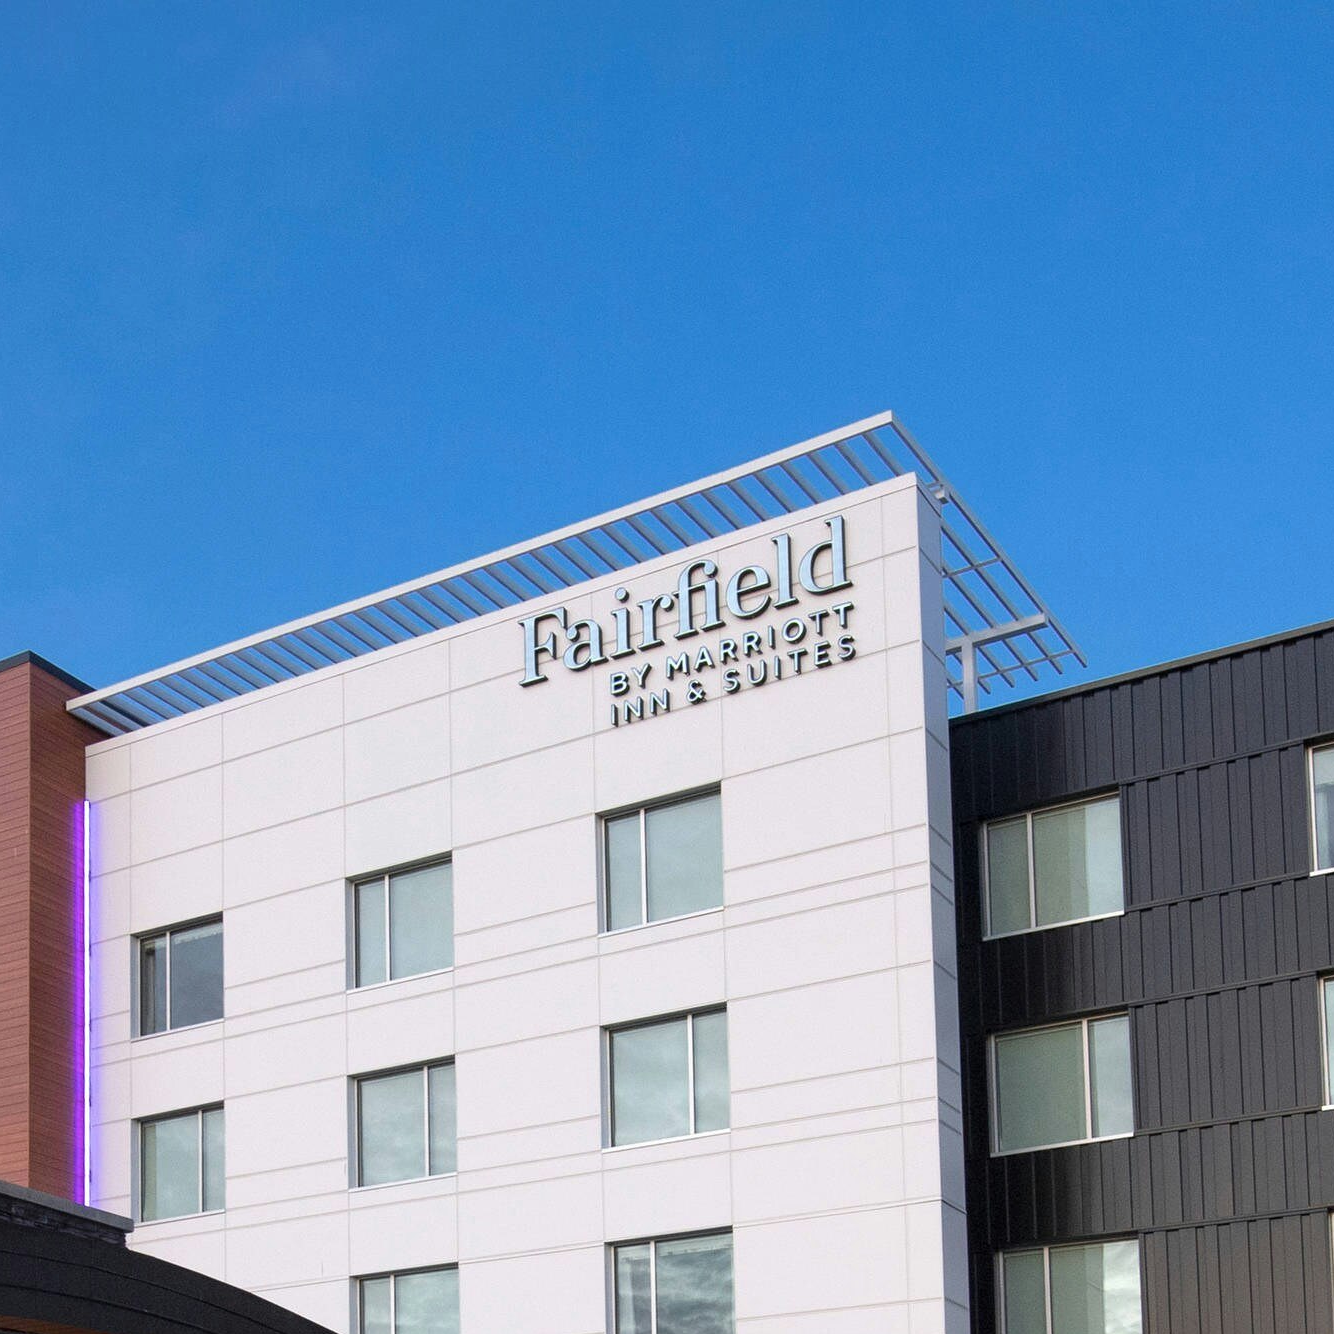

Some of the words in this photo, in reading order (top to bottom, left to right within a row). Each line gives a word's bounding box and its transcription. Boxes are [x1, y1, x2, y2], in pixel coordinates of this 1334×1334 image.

[518, 515, 853, 687] Fairfield
[610, 664, 652, 697] BY
[666, 602, 854, 681] MARRIOTT
[611, 688, 670, 727] INN
[686, 680, 707, 705] &
[723, 635, 857, 694] SUITES
